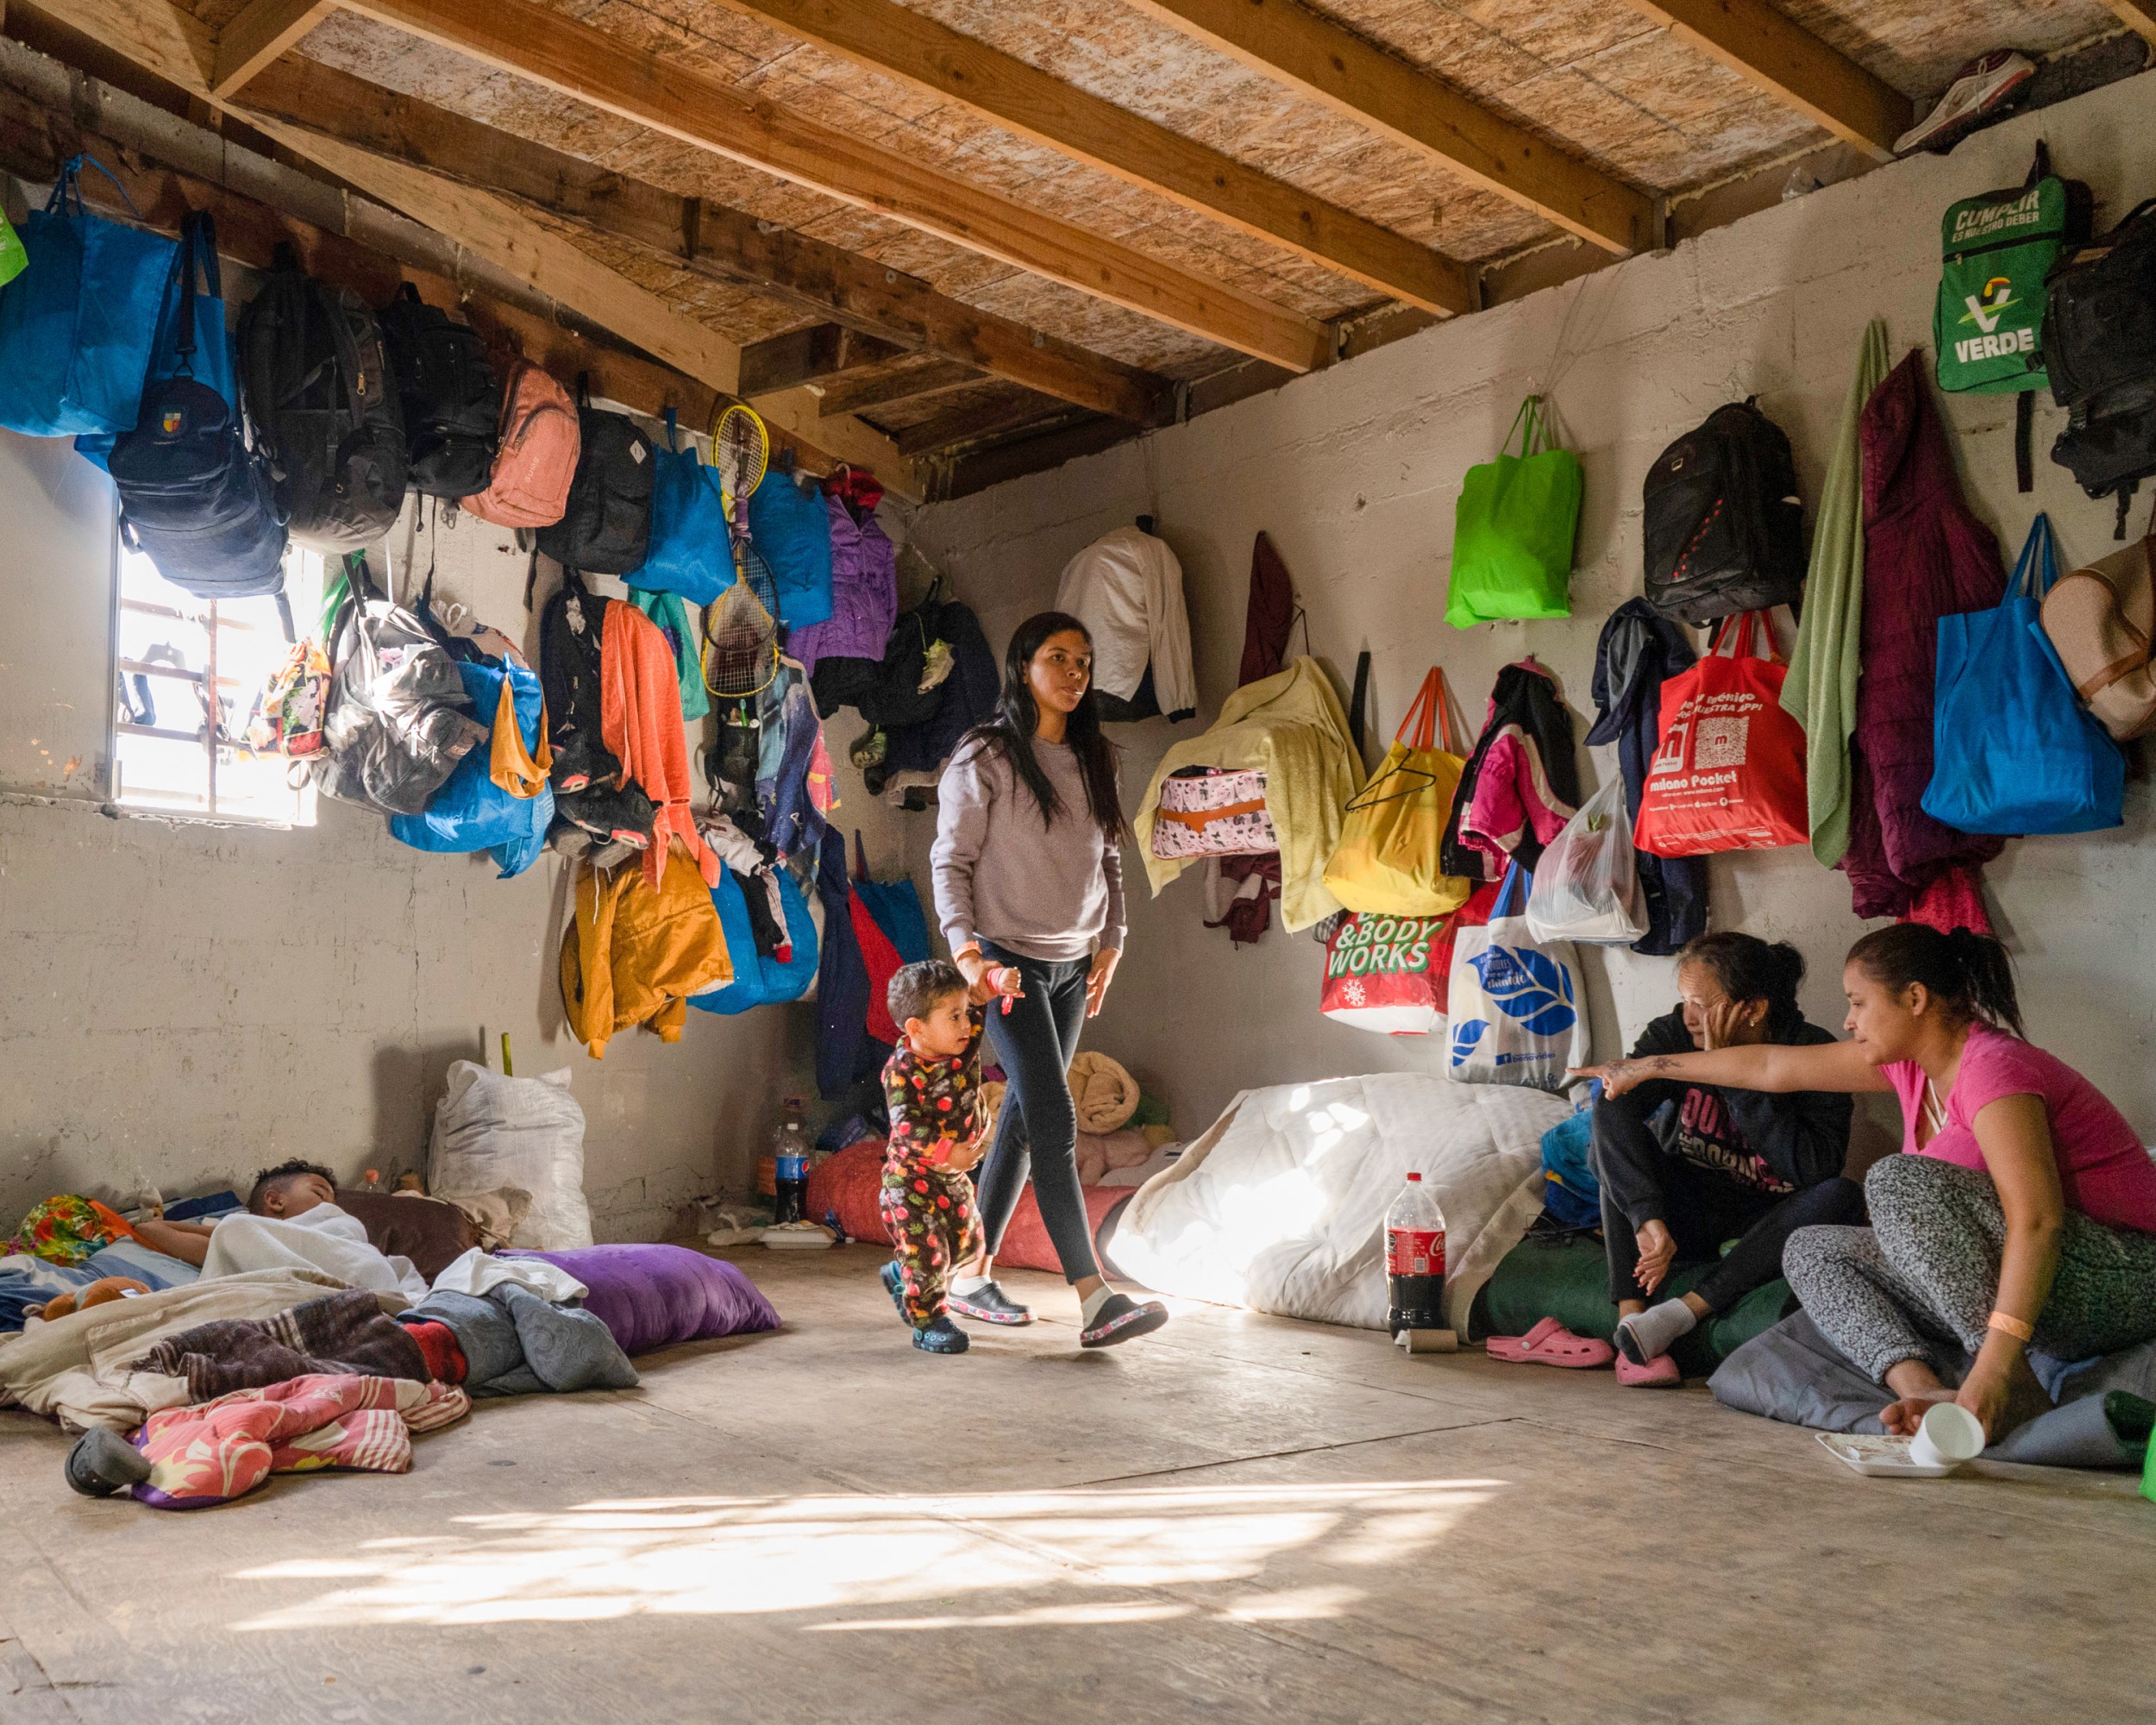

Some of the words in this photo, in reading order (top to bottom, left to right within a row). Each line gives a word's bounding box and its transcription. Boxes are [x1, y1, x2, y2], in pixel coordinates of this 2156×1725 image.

[1955, 190, 2040, 231] CUMPLIR
[1952, 231, 1964, 243] ES
[1964, 221, 2003, 241] NUESTRO
[2005, 211, 2040, 229] DEBER
[1954, 328, 2035, 363] VERDE
[1650, 778, 1689, 792] milano
[1691, 770, 1737, 787] Pocket
[1336, 919, 1444, 951] &BODY
[1328, 942, 1432, 980] WORKS
[1513, 1051, 1556, 1063] benavides
